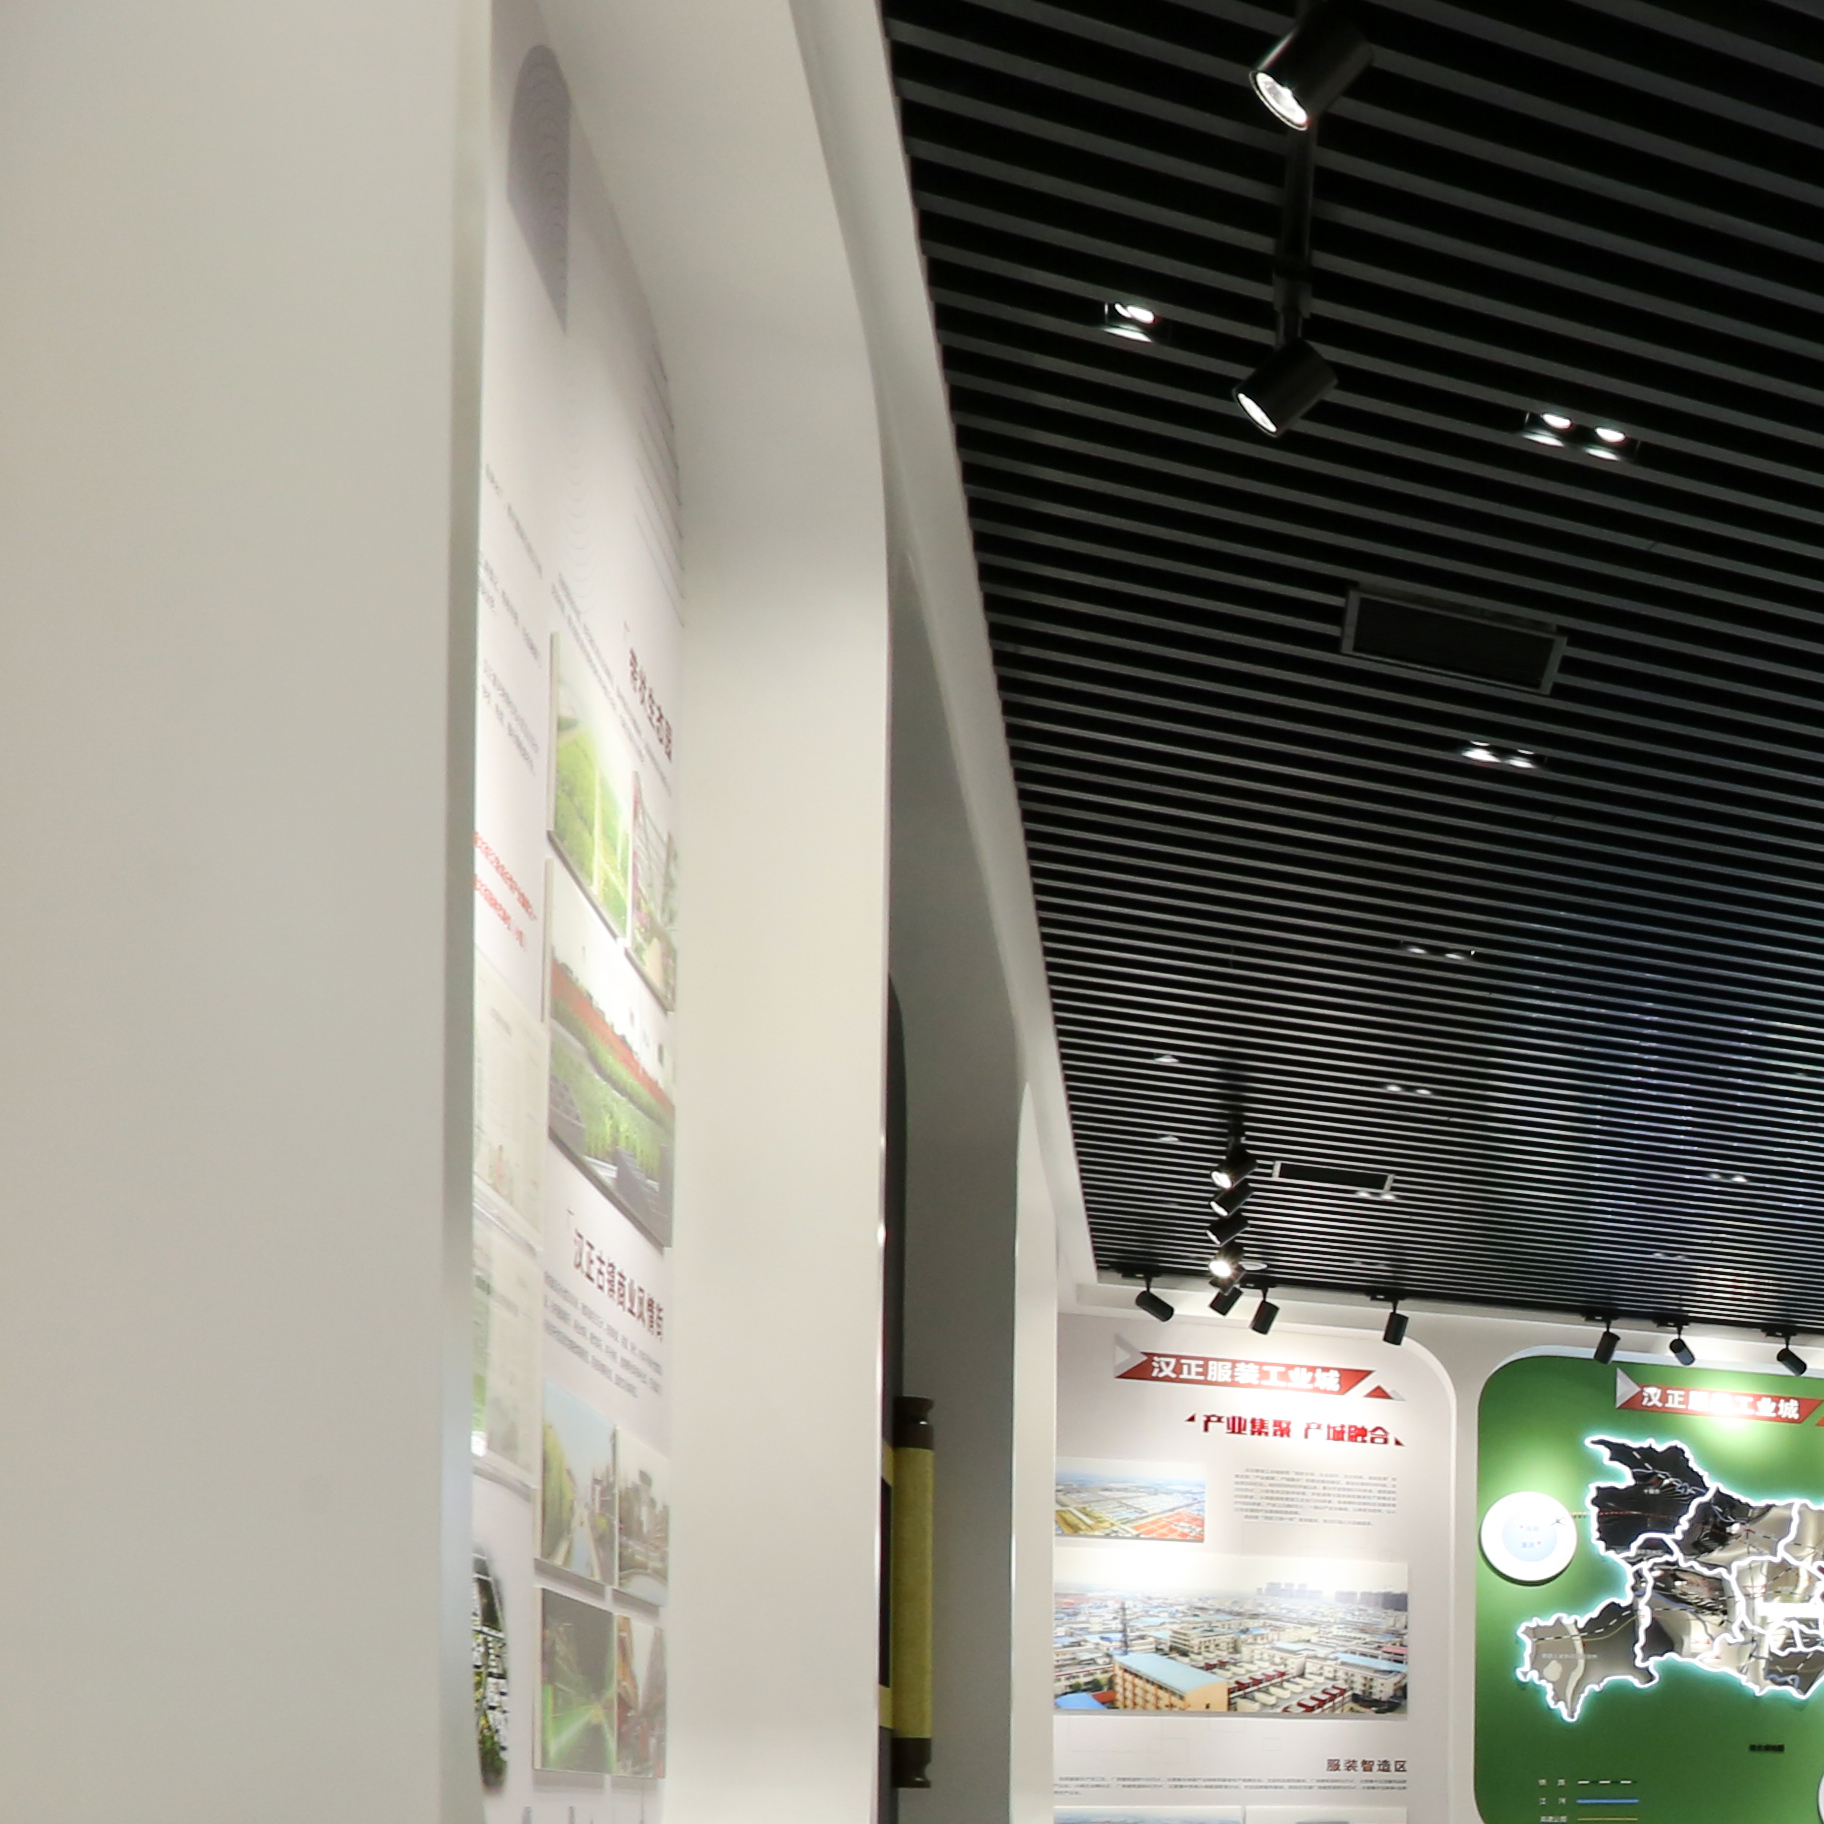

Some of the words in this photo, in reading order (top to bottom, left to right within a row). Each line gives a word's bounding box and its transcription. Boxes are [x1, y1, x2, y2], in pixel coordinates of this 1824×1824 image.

[1150, 1355, 1342, 1391] 汉正服装工业城
[1203, 1413, 1292, 1439] 产业集聚
[1304, 1421, 1390, 1446] 产城融合
[1326, 1757, 1408, 1774] 服装智造区
